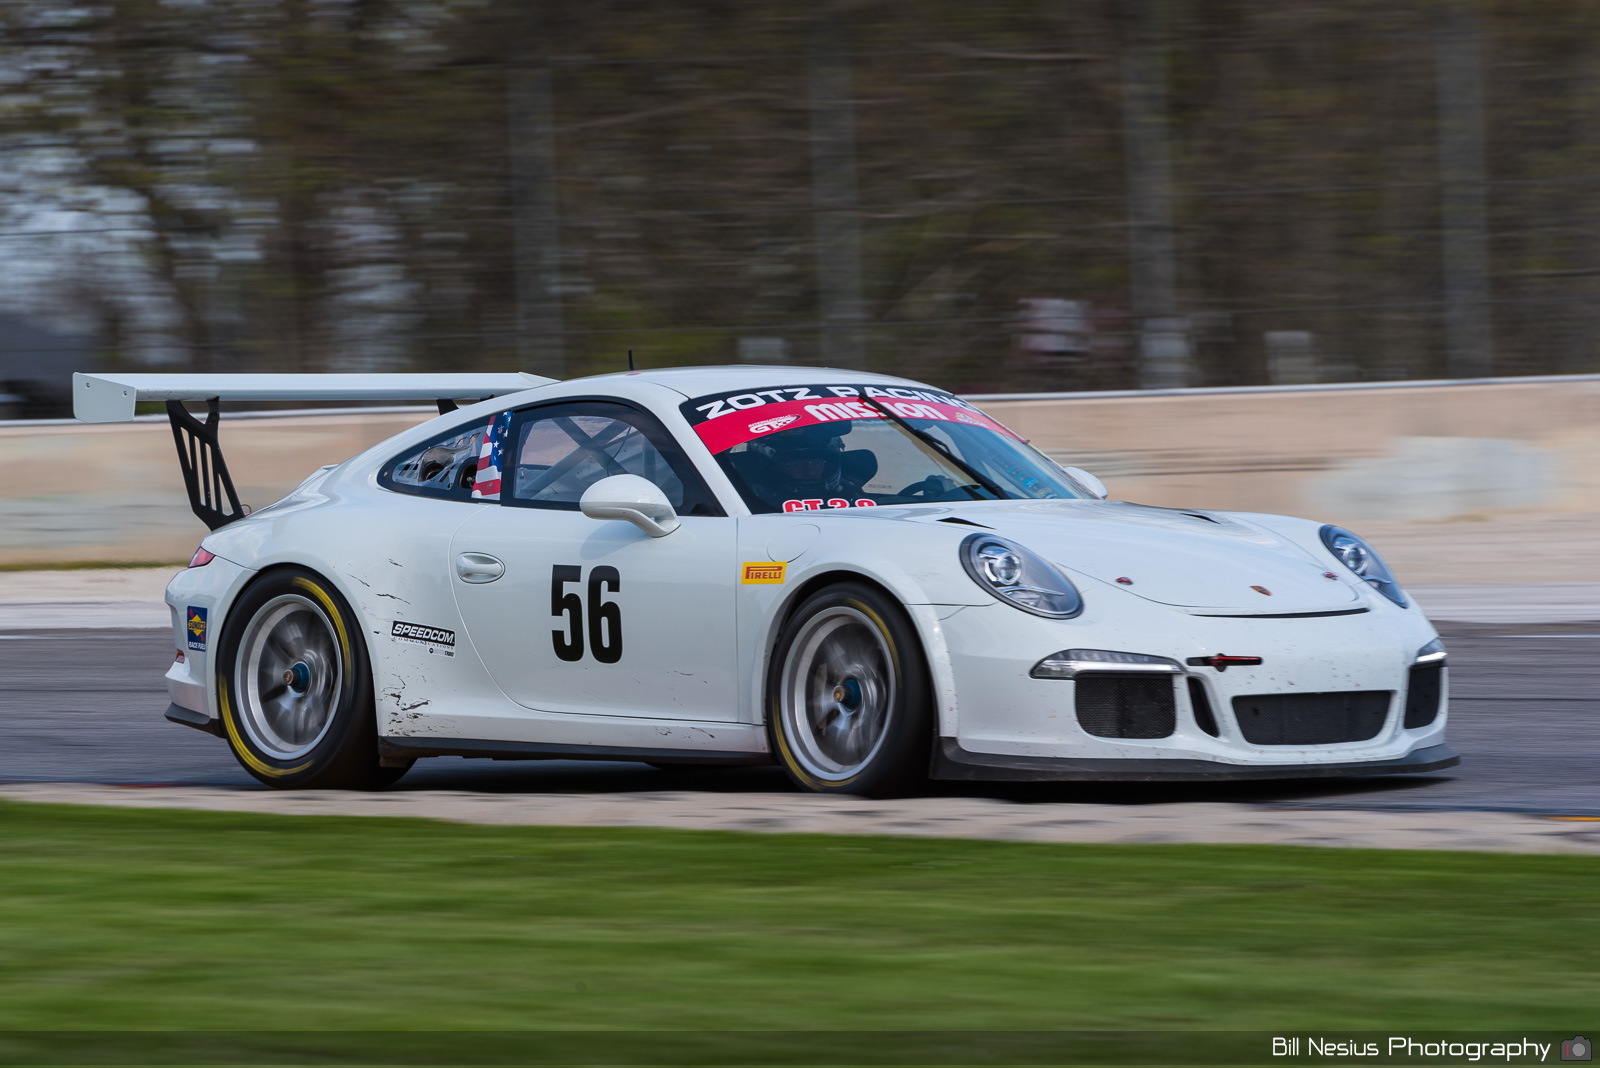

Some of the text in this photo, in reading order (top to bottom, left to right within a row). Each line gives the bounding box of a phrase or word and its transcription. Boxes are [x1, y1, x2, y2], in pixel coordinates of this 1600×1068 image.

[695, 387, 823, 420] ZOTZ
[745, 565, 783, 579] PIRELLI
[551, 564, 623, 664] 56
[392, 623, 455, 644] SPEEDCOM
